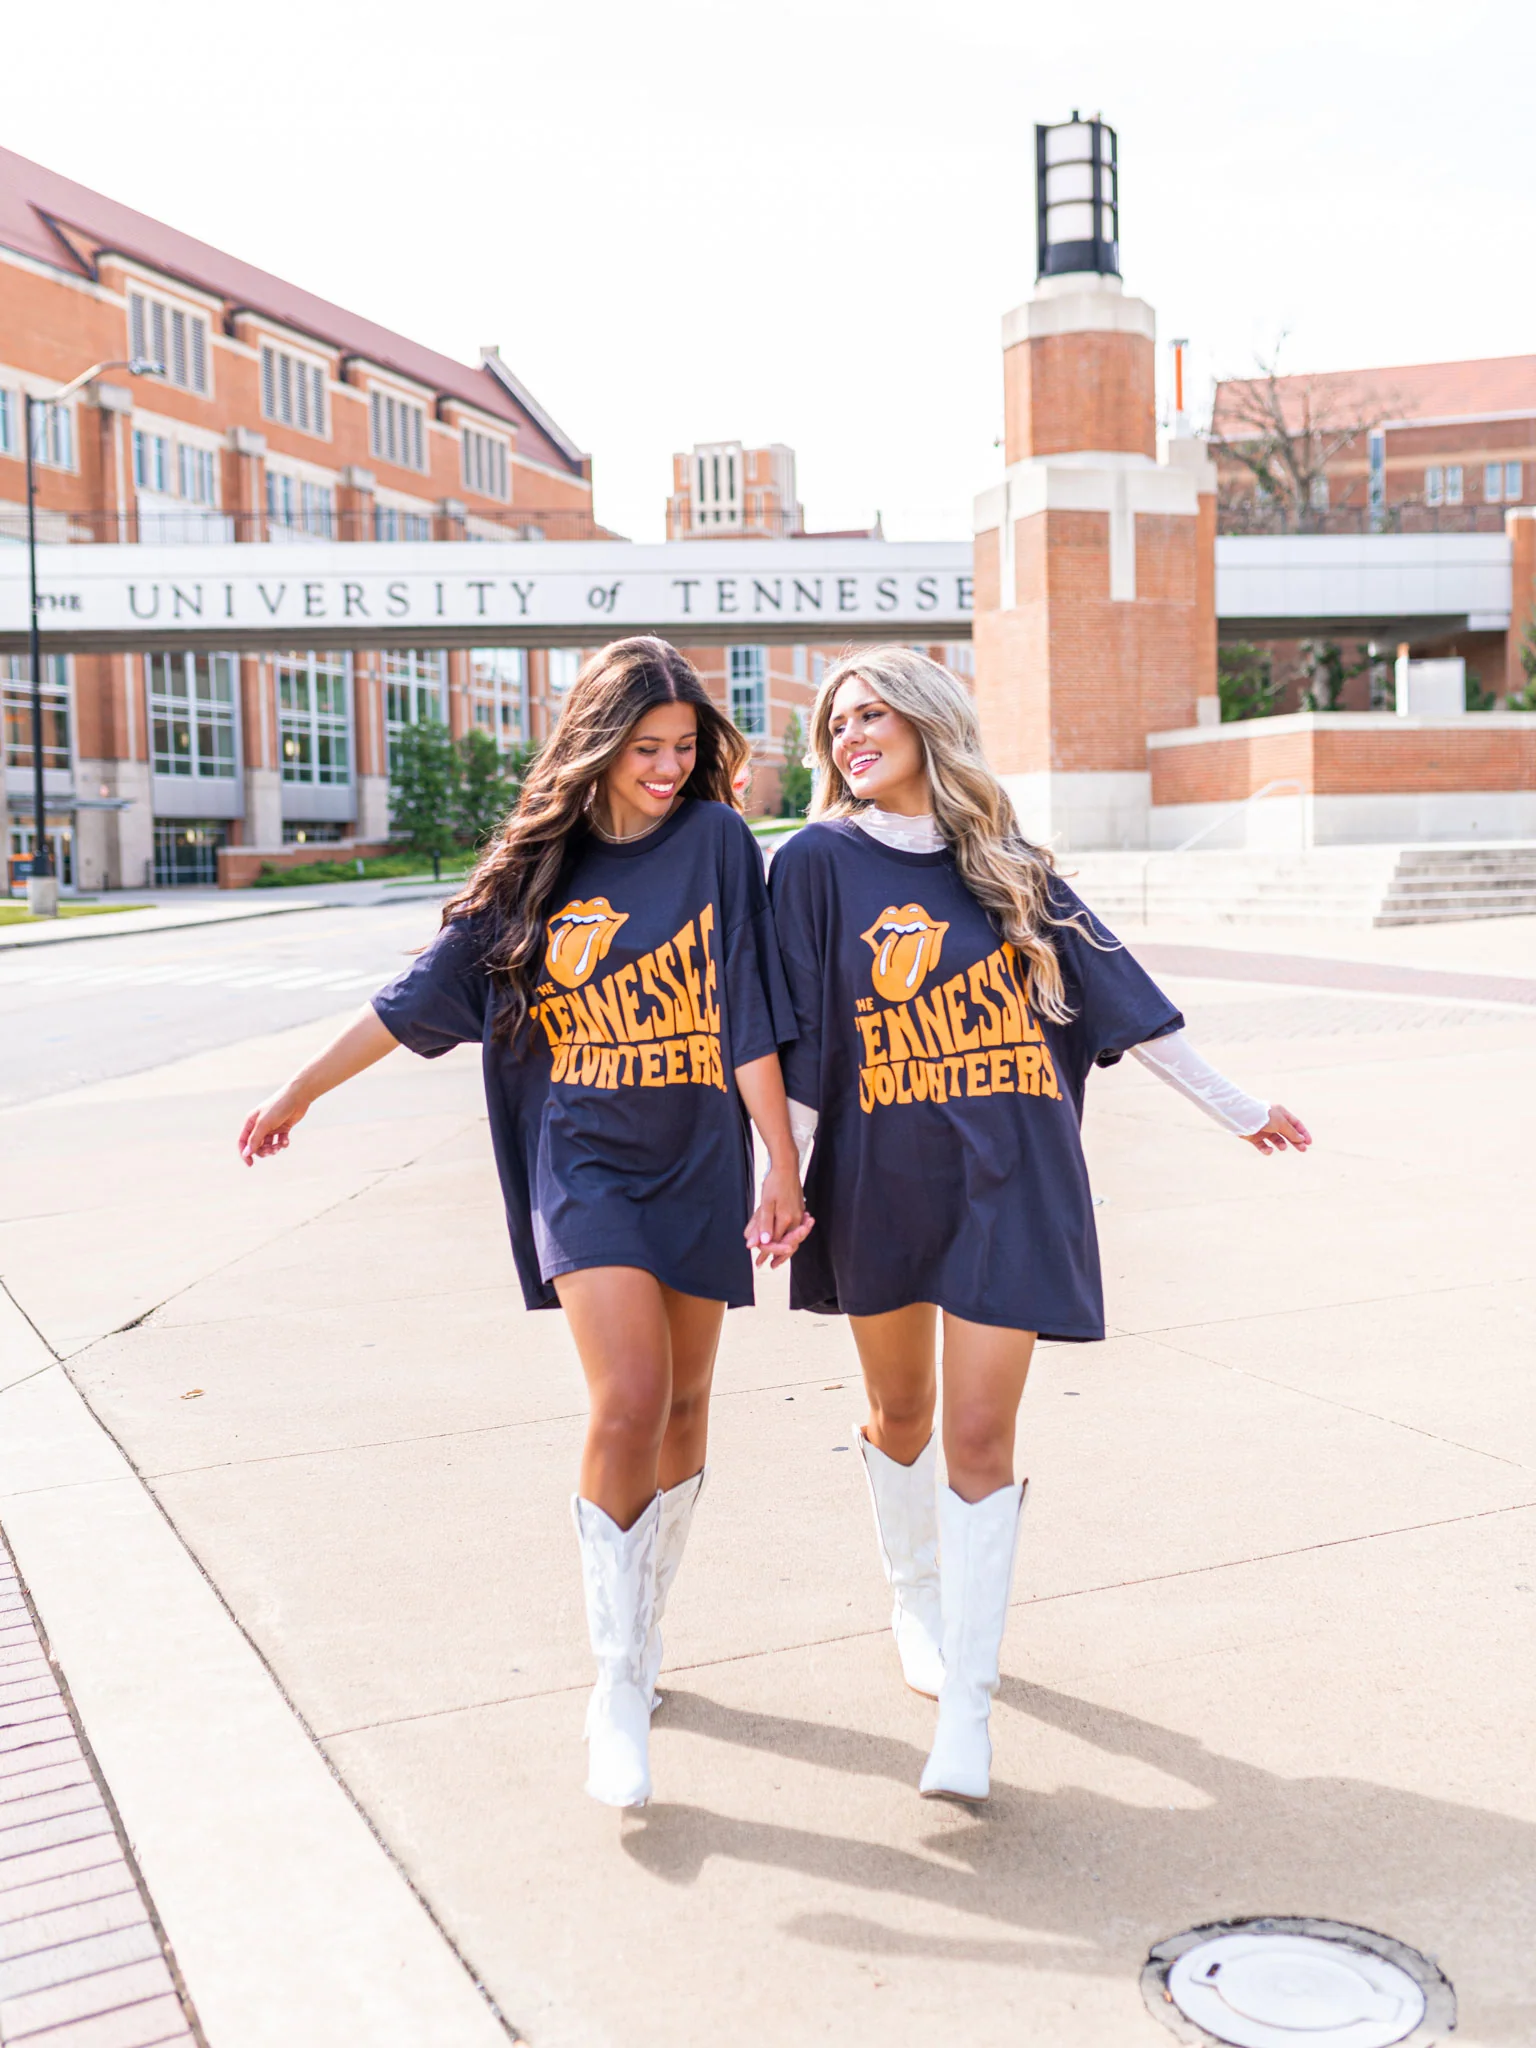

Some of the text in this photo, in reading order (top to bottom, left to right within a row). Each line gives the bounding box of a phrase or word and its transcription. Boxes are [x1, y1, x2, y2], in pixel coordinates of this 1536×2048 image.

[128, 580, 536, 619] UNIVERSITY
[586, 580, 623, 613] of
[673, 576, 973, 614] TENNESSE
[535, 981, 557, 997] HE
[855, 996, 875, 1013] HE
